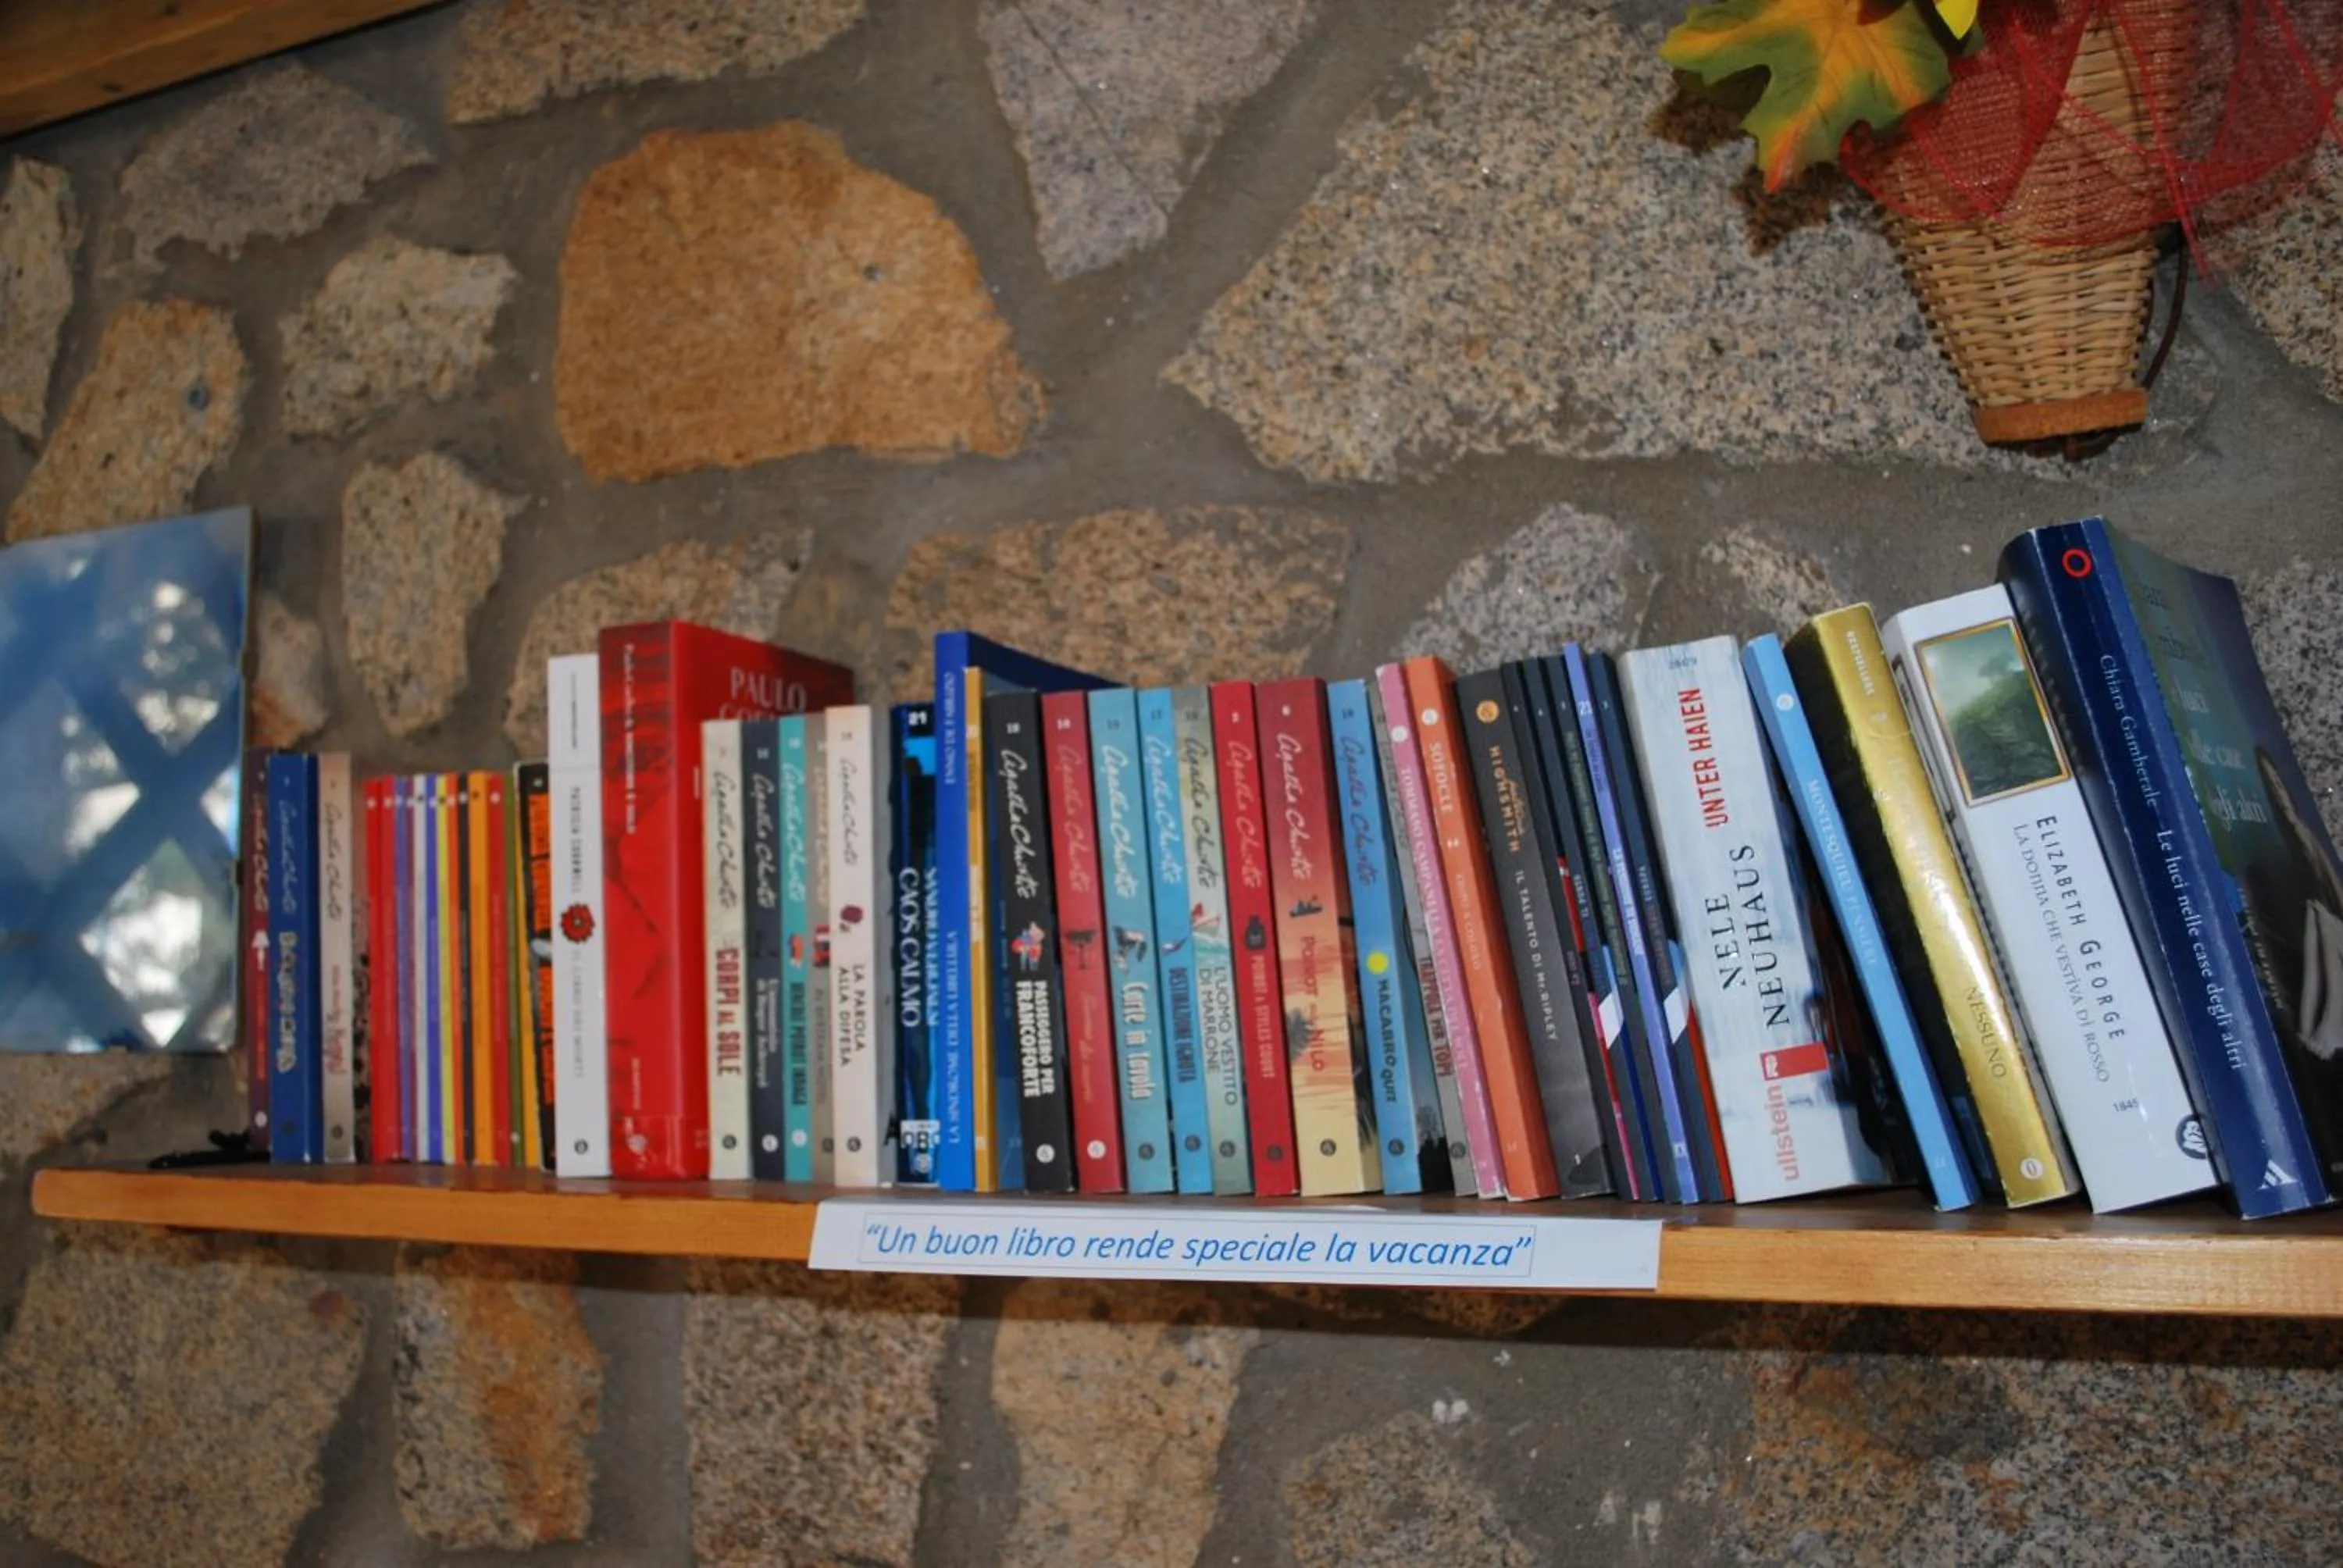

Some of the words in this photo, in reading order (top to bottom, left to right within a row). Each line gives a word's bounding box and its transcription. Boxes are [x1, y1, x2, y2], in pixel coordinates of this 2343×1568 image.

[729, 665, 807, 711] PAULO
[1678, 687, 1713, 752] HAIEN
[1428, 741, 1454, 816] SOFOCLE
[1488, 744, 1521, 854] HIGHSMITH
[1693, 757, 1728, 829] UNTER
[1400, 766, 1425, 837] TOMMASO
[1413, 840, 1443, 938] CAMPANELLA
[1807, 778, 1853, 890] MONTESQUIEU
[2013, 824, 2030, 847] LA
[2100, 655, 2124, 711] Chiara
[2120, 716, 2160, 807] Gamberale
[2156, 830, 2174, 851] Le
[2166, 856, 2188, 889] luci
[2178, 895, 2202, 936] nelle
[2193, 943, 2213, 977] case
[2207, 982, 2232, 1025] degli
[2222, 1032, 2246, 1070] altri
[898, 867, 921, 935] CAOS
[1513, 869, 1525, 884] IL
[2021, 850, 2050, 907] DONNA
[1517, 889, 1539, 949] TALENTO
[1705, 893, 1747, 990] NELE
[1728, 844, 1790, 1028] NEUHAUS
[2036, 815, 2087, 926] ELIZABETH
[2079, 939, 2125, 1040] GEORGE
[2042, 908, 2063, 943] CHE
[715, 947, 740, 1005] CORPI
[839, 966, 854, 1005] ALLA
[852, 964, 867, 983] LA
[899, 937, 922, 1028] CALMO
[1197, 968, 1213, 985] DI
[1250, 954, 1268, 993] POIROT
[1300, 936, 1319, 997] POIROT
[1531, 953, 1543, 969] DI
[854, 989, 868, 1053] PAROLA
[1032, 979, 1054, 1064] PASSEGGERO
[1122, 982, 1150, 1025] Carte
[1213, 965, 1233, 1032] L'UOMO
[1378, 978, 1398, 1067] MACABRO
[2076, 1009, 2095, 1028] DI
[715, 1030, 741, 1078] SOLE
[839, 1010, 853, 1067] DIFESA
[1015, 979, 1041, 1098] FRANCOFORTE
[1125, 1030, 1152, 1047] in
[1199, 989, 1220, 1074] MARRONE
[1308, 1028, 1326, 1072] NILO
[1434, 1045, 1455, 1078] TOPI
[1967, 985, 2007, 1078] NESSUNO
[2084, 1031, 2110, 1083] ROSSO
[1040, 1067, 1056, 1096] PER
[1127, 1051, 1157, 1099] tavola
[1221, 1038, 1239, 1106] VESTITO
[1764, 1084, 1800, 1182] ullstein
[924, 1226, 998, 1257] buon
[1007, 1227, 1075, 1259] libro
[1083, 1230, 1175, 1262] rende
[1182, 1231, 1317, 1267] speciale
[1325, 1233, 1357, 1263] la
